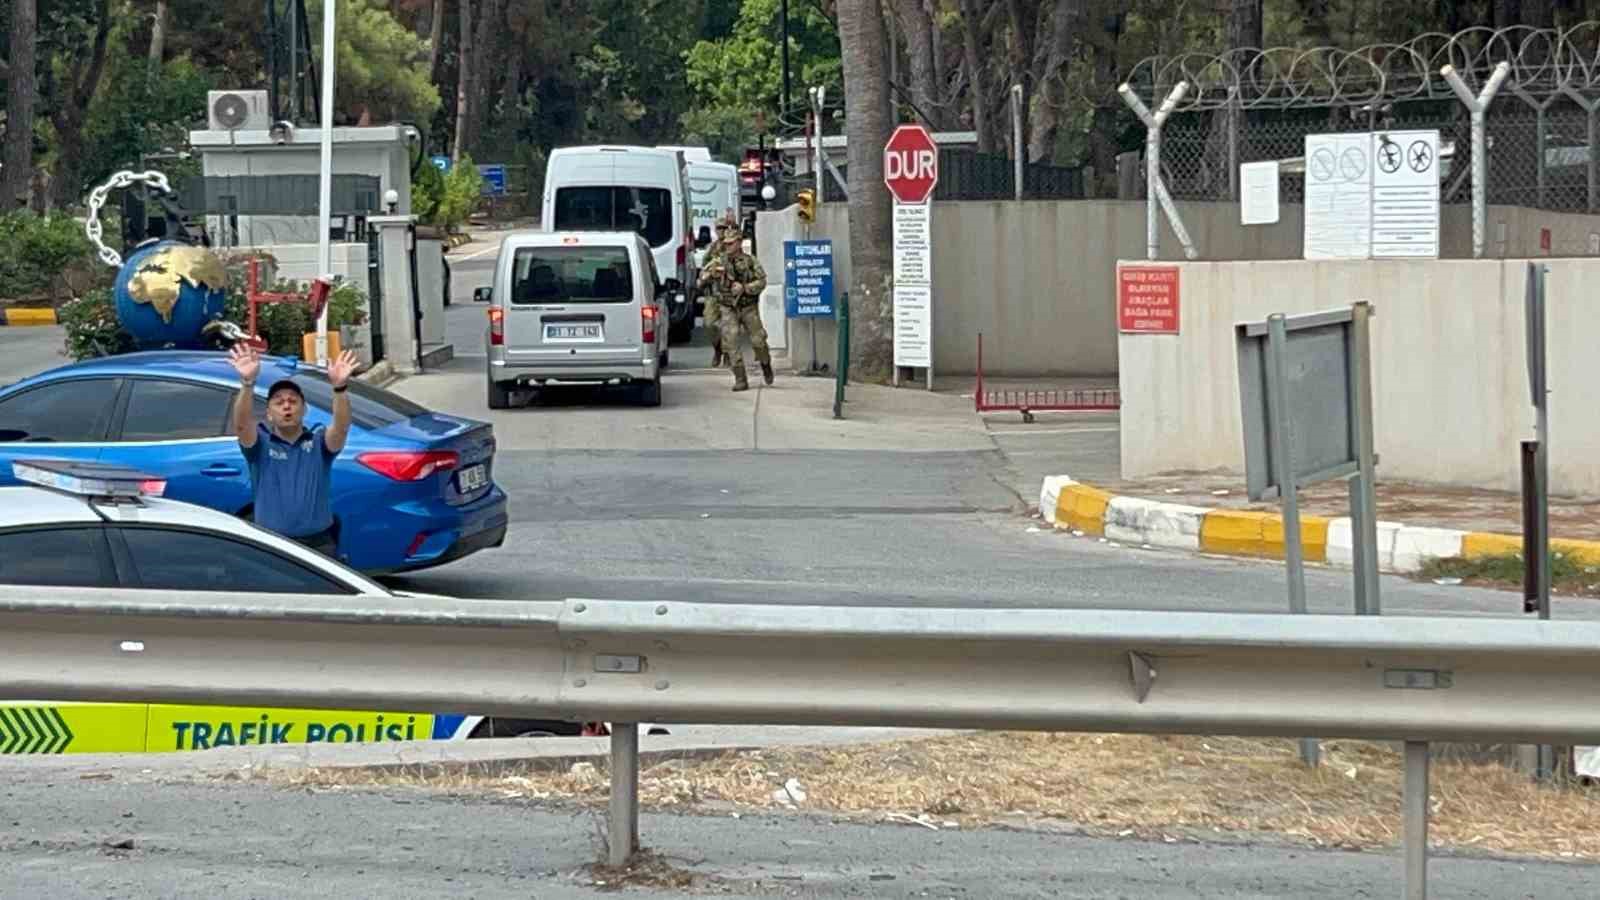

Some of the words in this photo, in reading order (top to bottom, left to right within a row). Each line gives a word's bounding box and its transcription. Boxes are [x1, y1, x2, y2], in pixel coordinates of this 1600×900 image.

[887, 150, 934, 179] DUR
[172, 713, 294, 750] TRAFİK
[306, 714, 415, 743] POLİSİ
